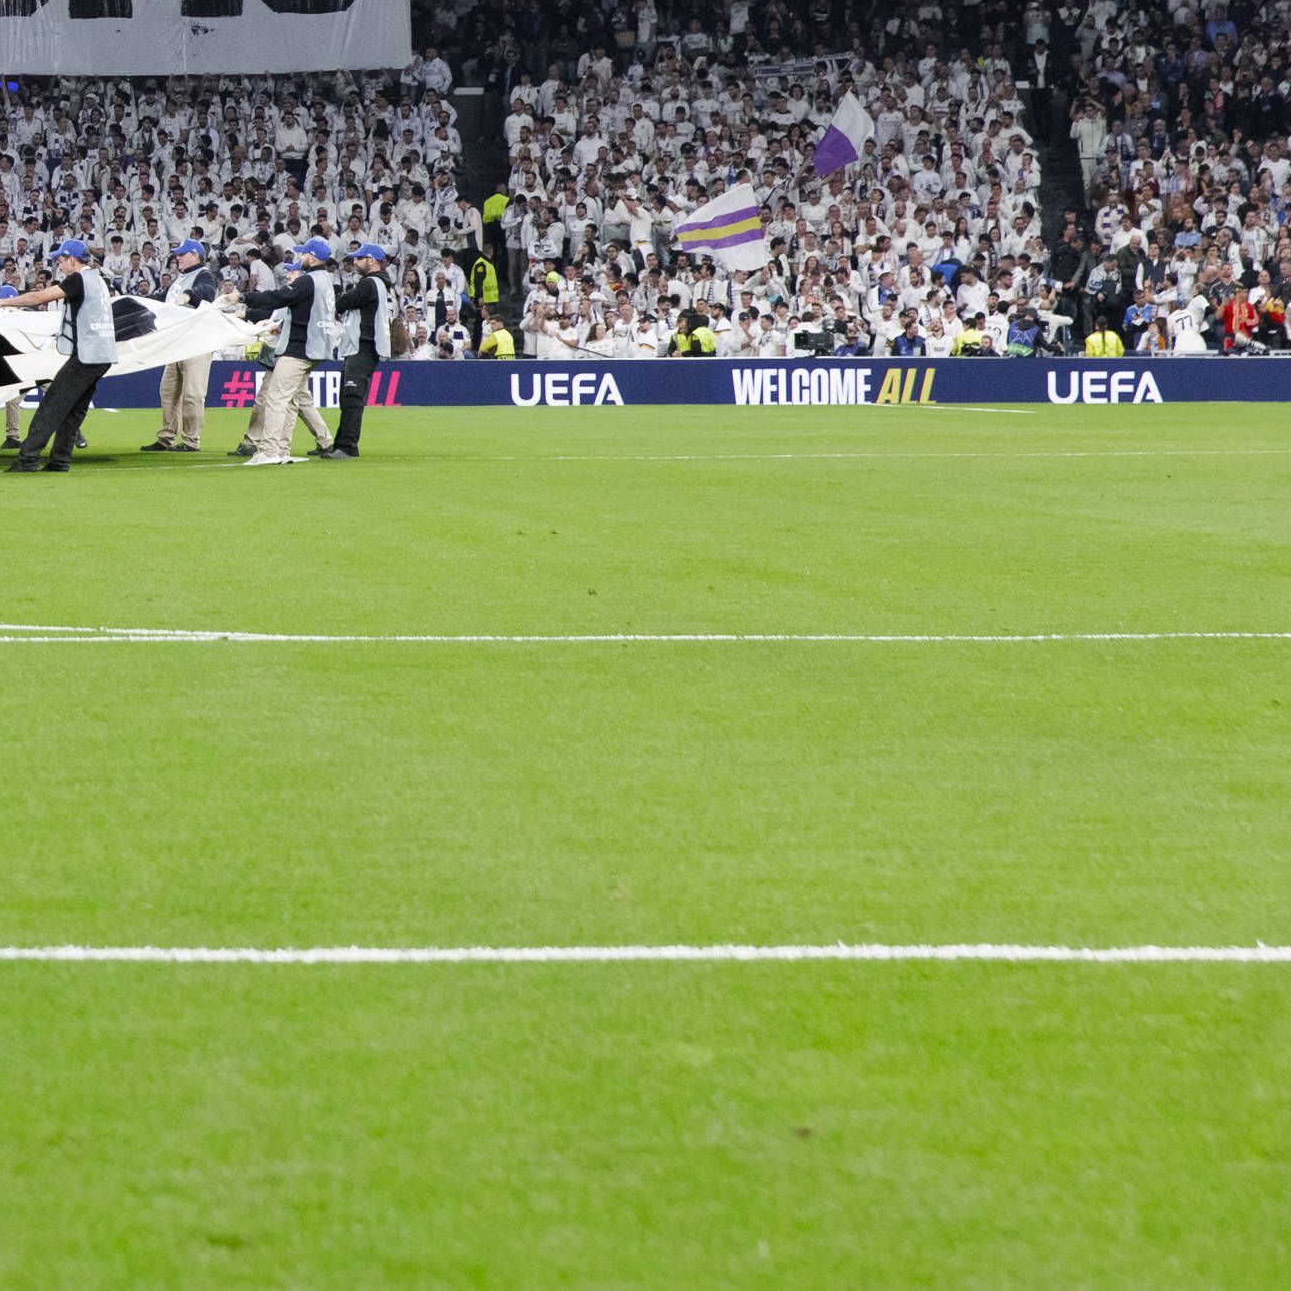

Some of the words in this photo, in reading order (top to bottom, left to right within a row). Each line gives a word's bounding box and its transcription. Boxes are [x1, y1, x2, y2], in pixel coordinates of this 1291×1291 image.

[1175, 315, 1193, 330] 77
[511, 373, 625, 406] UEFA
[732, 368, 871, 405] WELCOME
[876, 367, 936, 404] ALL
[1047, 371, 1163, 404] UEFA
